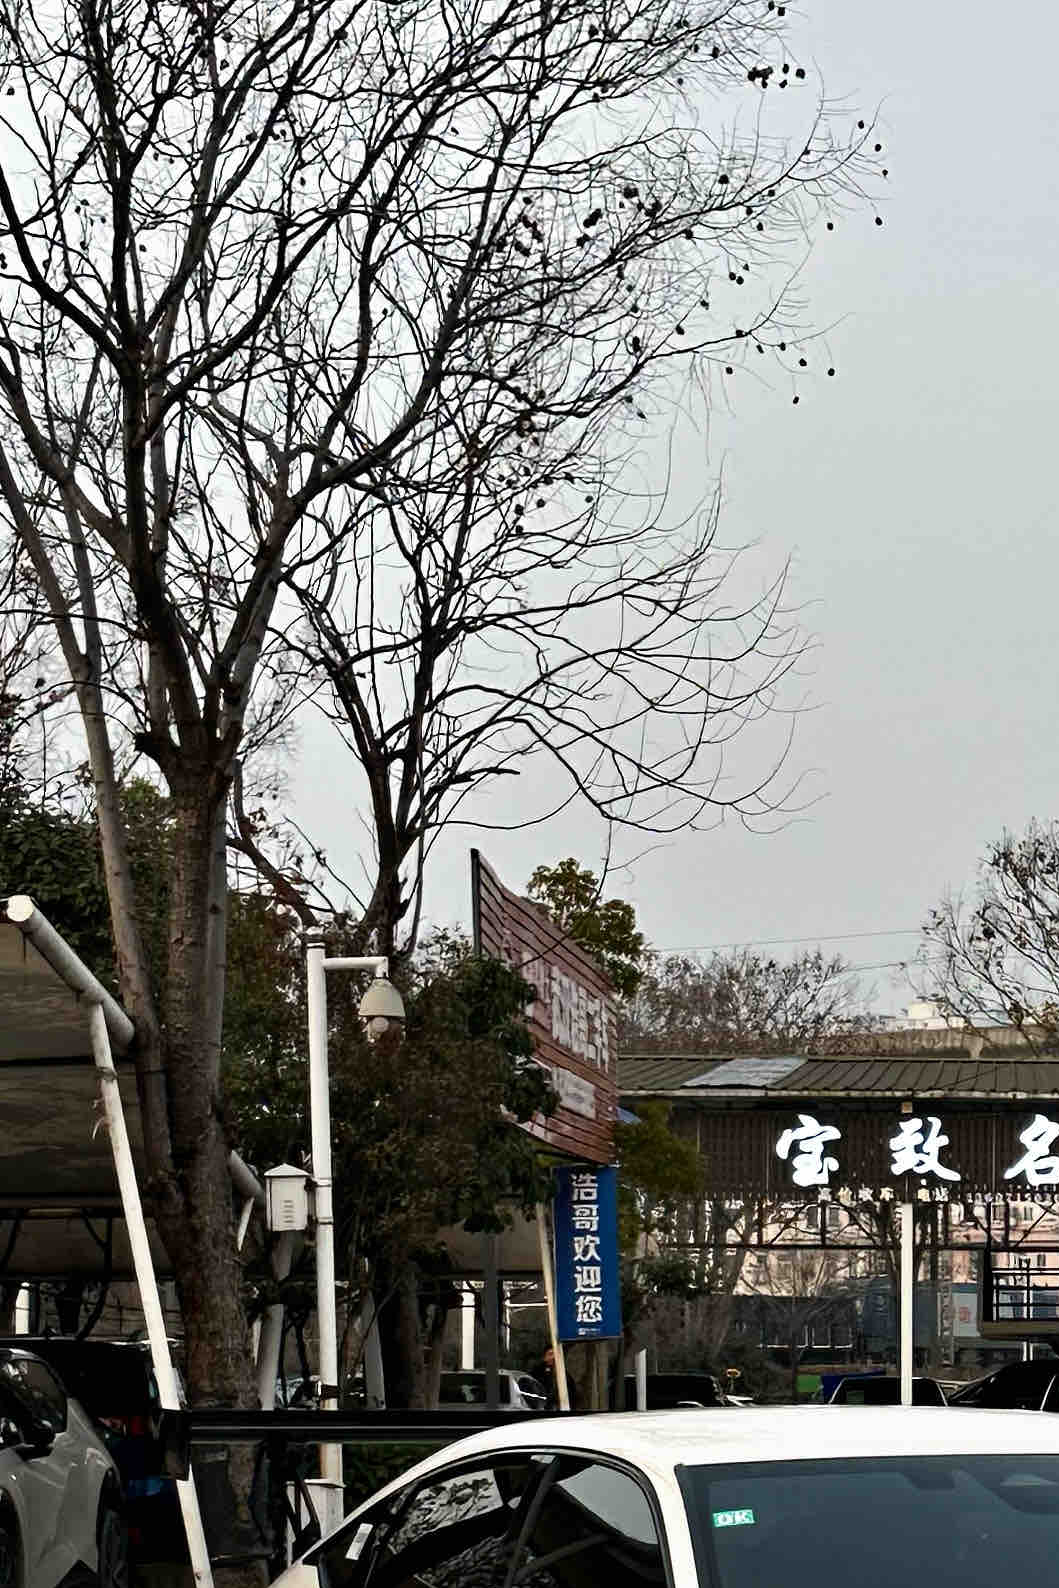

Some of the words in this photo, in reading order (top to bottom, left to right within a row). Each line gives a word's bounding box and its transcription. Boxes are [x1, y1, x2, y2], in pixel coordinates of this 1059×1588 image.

[570, 1173, 603, 1323] 浩哥欢迎您
